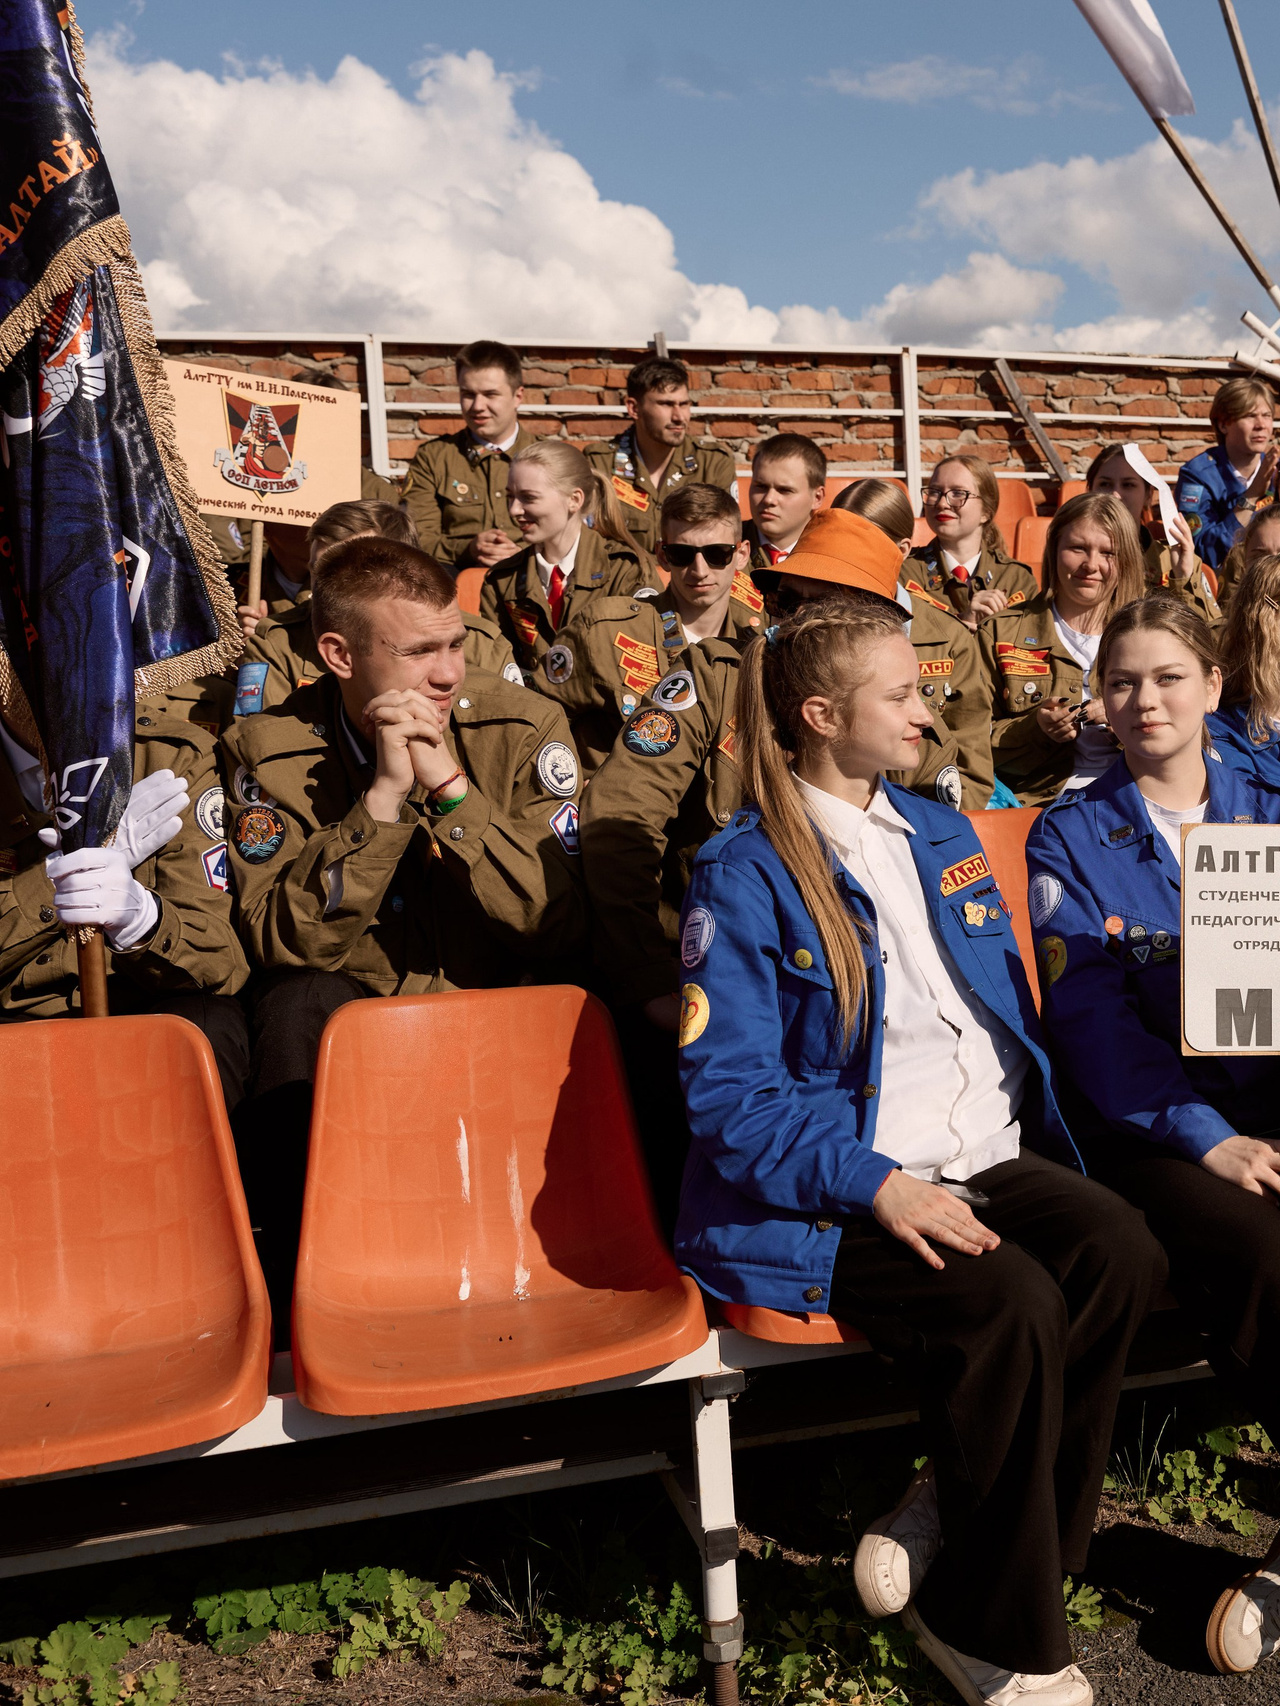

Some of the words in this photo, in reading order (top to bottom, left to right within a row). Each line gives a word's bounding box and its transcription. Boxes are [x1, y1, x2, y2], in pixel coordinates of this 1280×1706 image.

[197, 498, 246, 510] енческий
[251, 504, 284, 515] отряд
[1233, 940, 1280, 952] ОТРЯД
